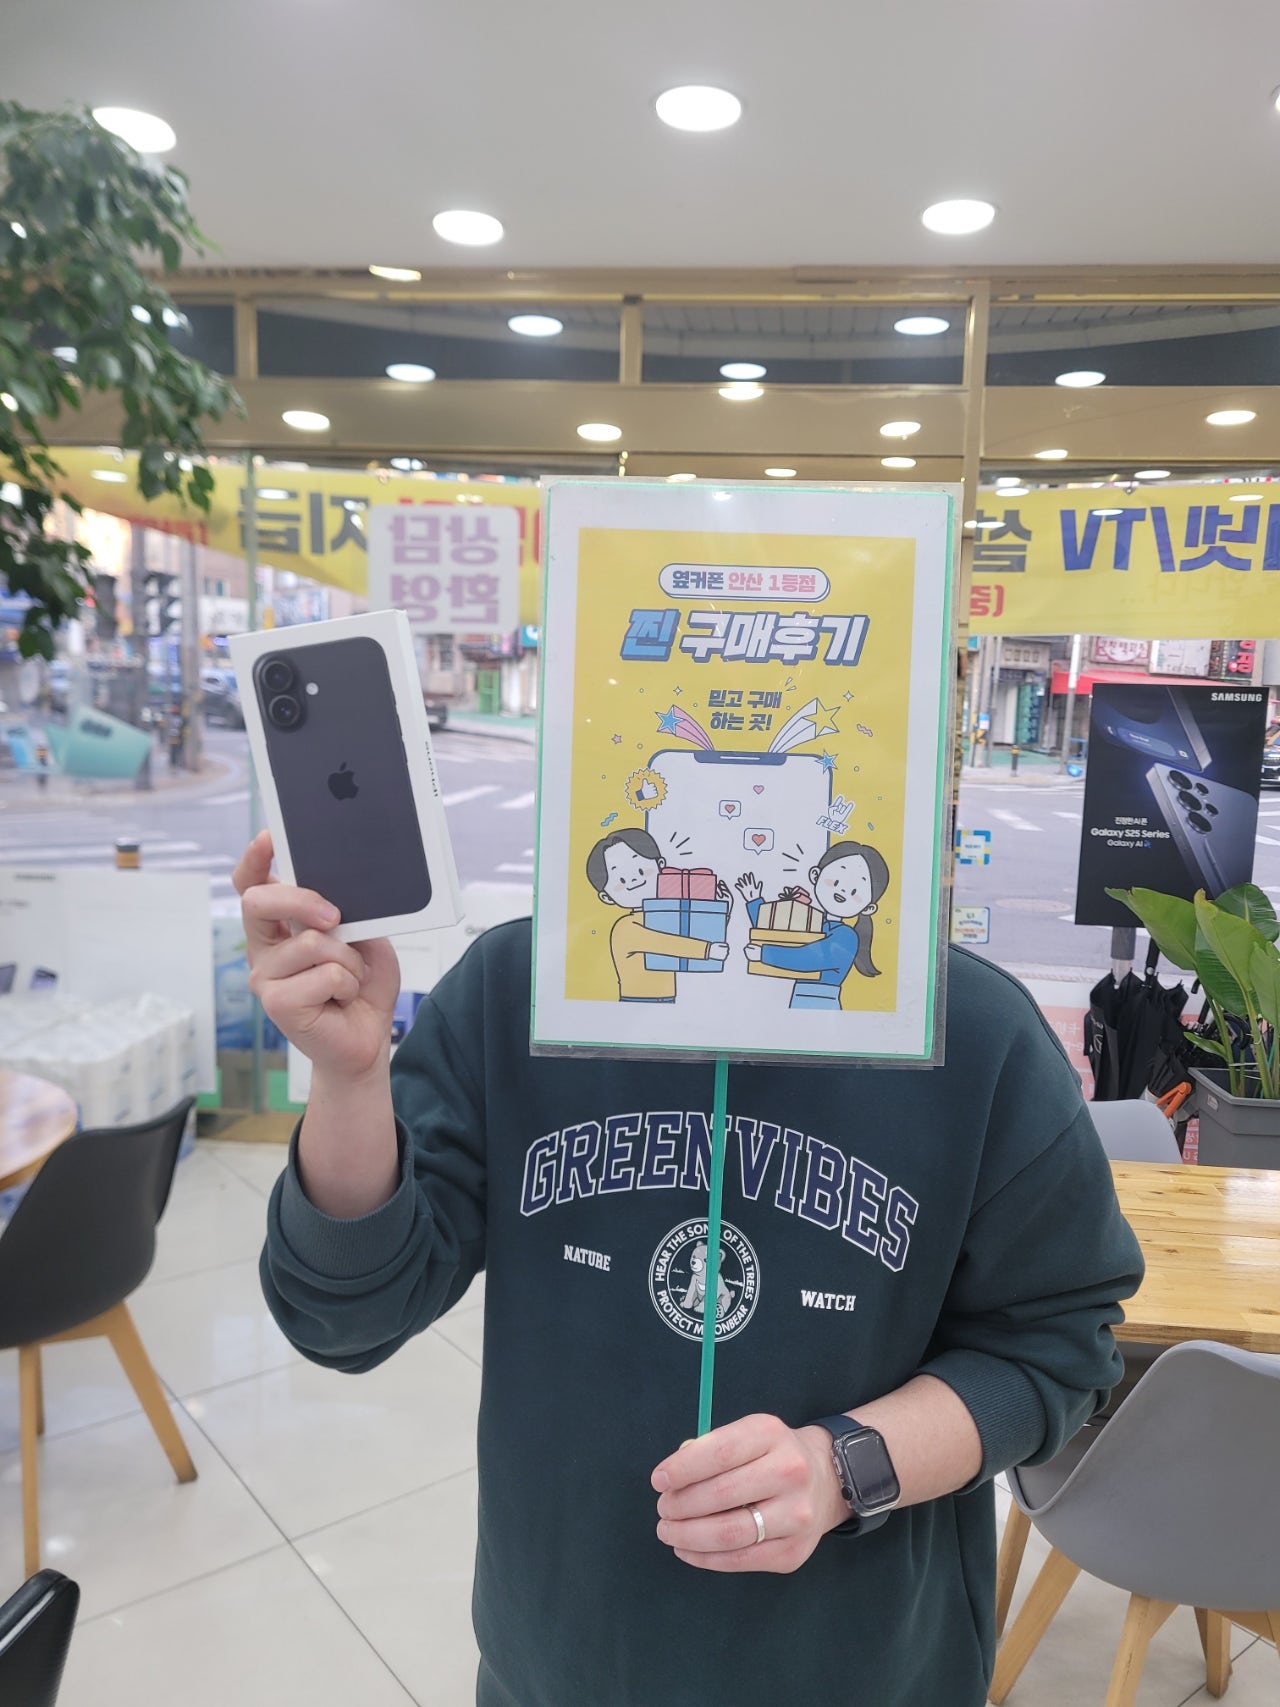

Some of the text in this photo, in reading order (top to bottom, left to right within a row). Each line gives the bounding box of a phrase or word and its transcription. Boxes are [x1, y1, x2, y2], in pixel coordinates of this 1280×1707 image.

[672, 570, 816, 593] 옆커폰 안산 1등점
[620, 608, 870, 666] 찐 구매후기
[708, 689, 782, 709] 믿고 구매
[1211, 692, 1263, 703] SAMSUNG
[710, 712, 773, 731] 하는 곳!
[815, 815, 849, 835] FLEX
[1090, 827, 1170, 839] Galaxy S25 Series
[1107, 839, 1134, 848] Galaxy
[564, 1244, 611, 1272] NATURE
[655, 1224, 755, 1301] HEAR THE SON OF THE TREES
[801, 1289, 856, 1312] WATCH
[657, 1289, 749, 1336] PROTECT MONBEAR
